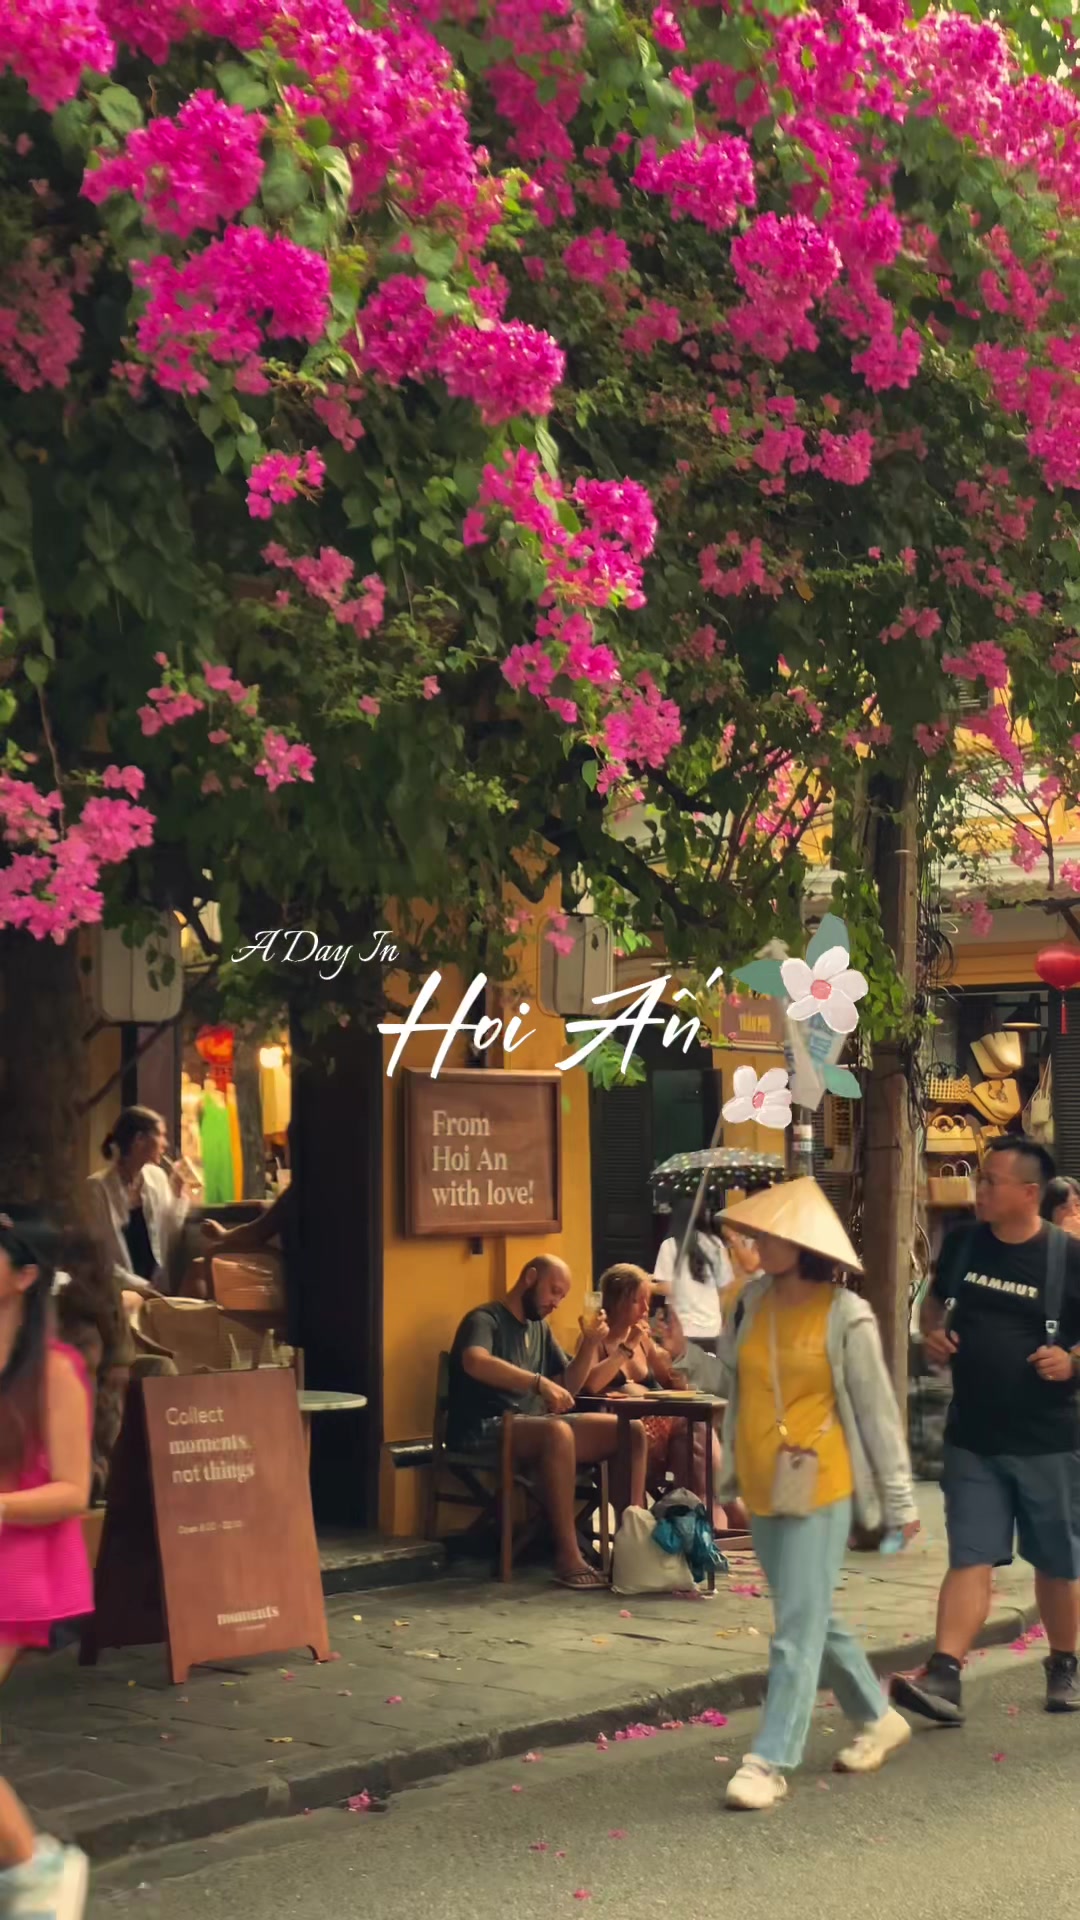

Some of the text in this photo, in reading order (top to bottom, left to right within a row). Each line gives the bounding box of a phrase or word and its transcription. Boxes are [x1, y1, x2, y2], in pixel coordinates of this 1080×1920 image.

[432, 1110, 491, 1136] From
[432, 1145, 508, 1171] Hoi An
[432, 1179, 534, 1206] with love!
[963, 1271, 1039, 1299] MAMMUT
[165, 1406, 225, 1426] Collect
[172, 1460, 255, 1483] not things
